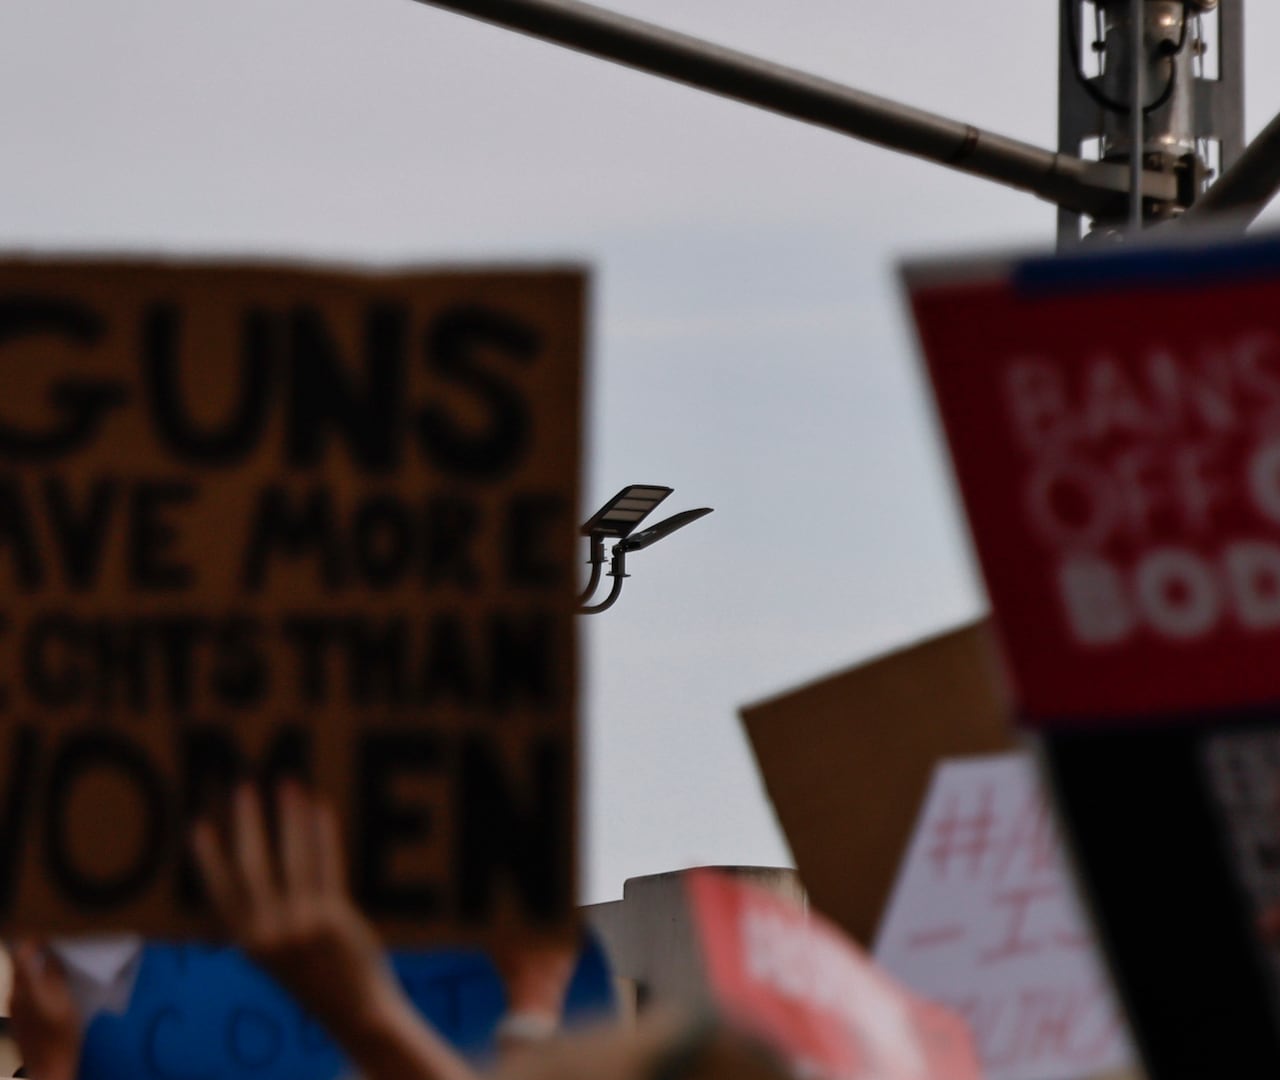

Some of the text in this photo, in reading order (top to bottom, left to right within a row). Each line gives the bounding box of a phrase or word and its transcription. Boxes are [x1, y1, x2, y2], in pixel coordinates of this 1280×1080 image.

[0, 297, 541, 480] GUNS
[246, 486, 568, 594] MORE
[1022, 441, 1226, 549] OFF
[0, 611, 265, 712] GHTS
